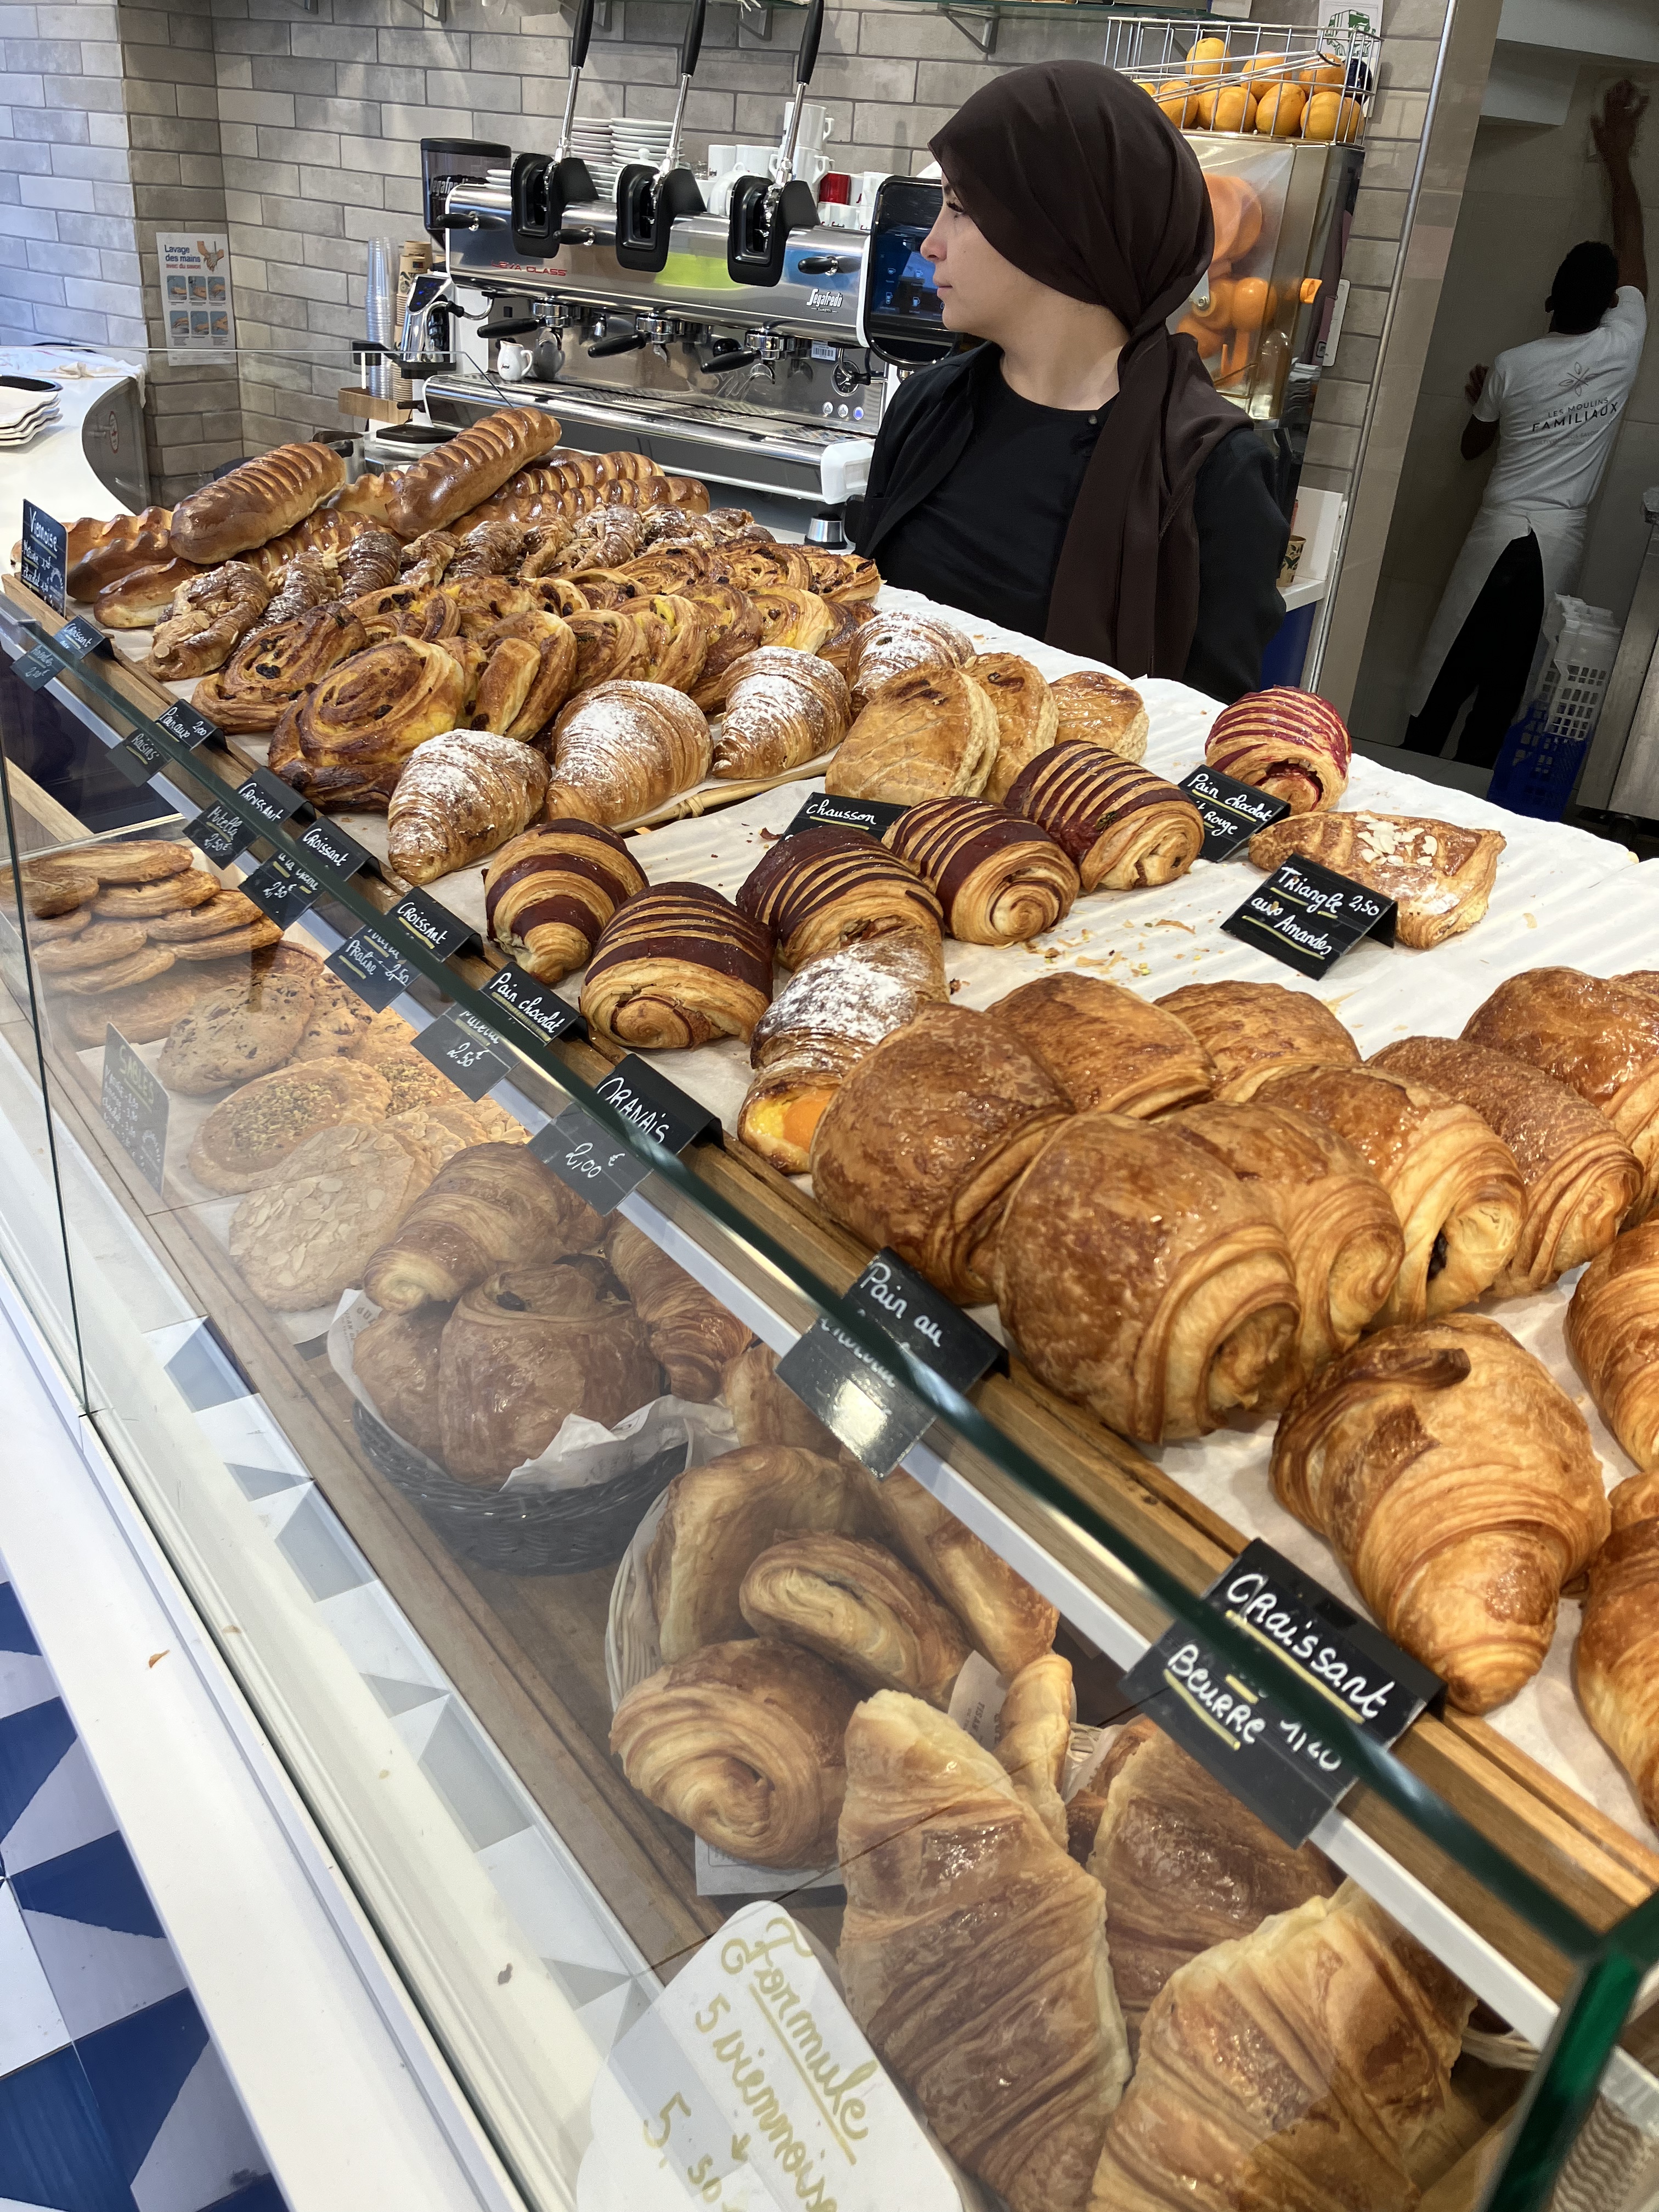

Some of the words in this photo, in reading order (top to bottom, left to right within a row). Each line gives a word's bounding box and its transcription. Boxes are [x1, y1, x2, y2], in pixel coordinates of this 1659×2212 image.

[164, 245, 190, 255] Lavage
[165, 254, 179, 262] des
[180, 255, 201, 263] mains
[526, 266, 568, 276] CLASS
[806, 288, 843, 308] Segafredo
[1532, 402, 1618, 432] FAMILIAUX
[1548, 409, 1564, 418] LES
[1567, 397, 1609, 413] MOULINS
[1187, 773, 1220, 799] Pain
[1204, 810, 1238, 837] Rouge
[1348, 895, 1380, 916] 2,50
[1273, 914, 1333, 955] Amandes
[489, 971, 518, 1003] Pain
[860, 1262, 908, 1319] Pain
[913, 1314, 944, 1348] au
[696, 1993, 731, 2034] 5
[720, 1916, 879, 2140] Formule
